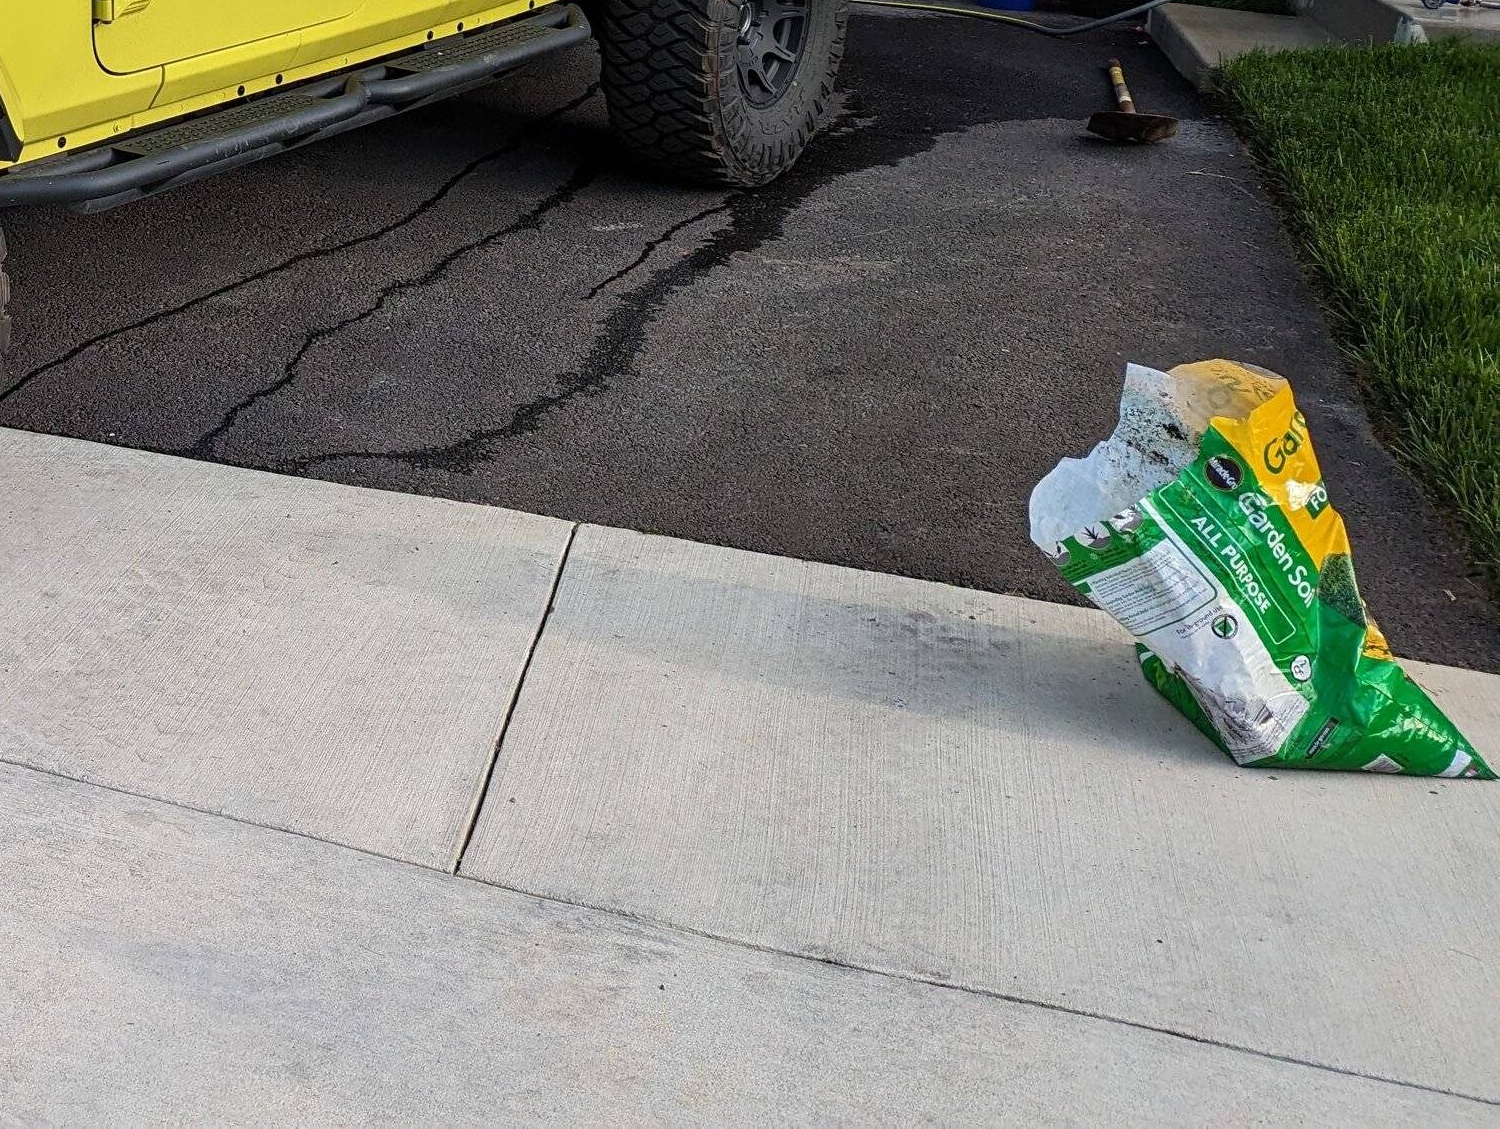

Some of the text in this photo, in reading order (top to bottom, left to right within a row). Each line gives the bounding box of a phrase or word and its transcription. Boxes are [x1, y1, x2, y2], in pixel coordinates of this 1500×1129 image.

[1190, 516, 1272, 615] ALL PURPOSE
[1238, 491, 1317, 609] Garden Soil
